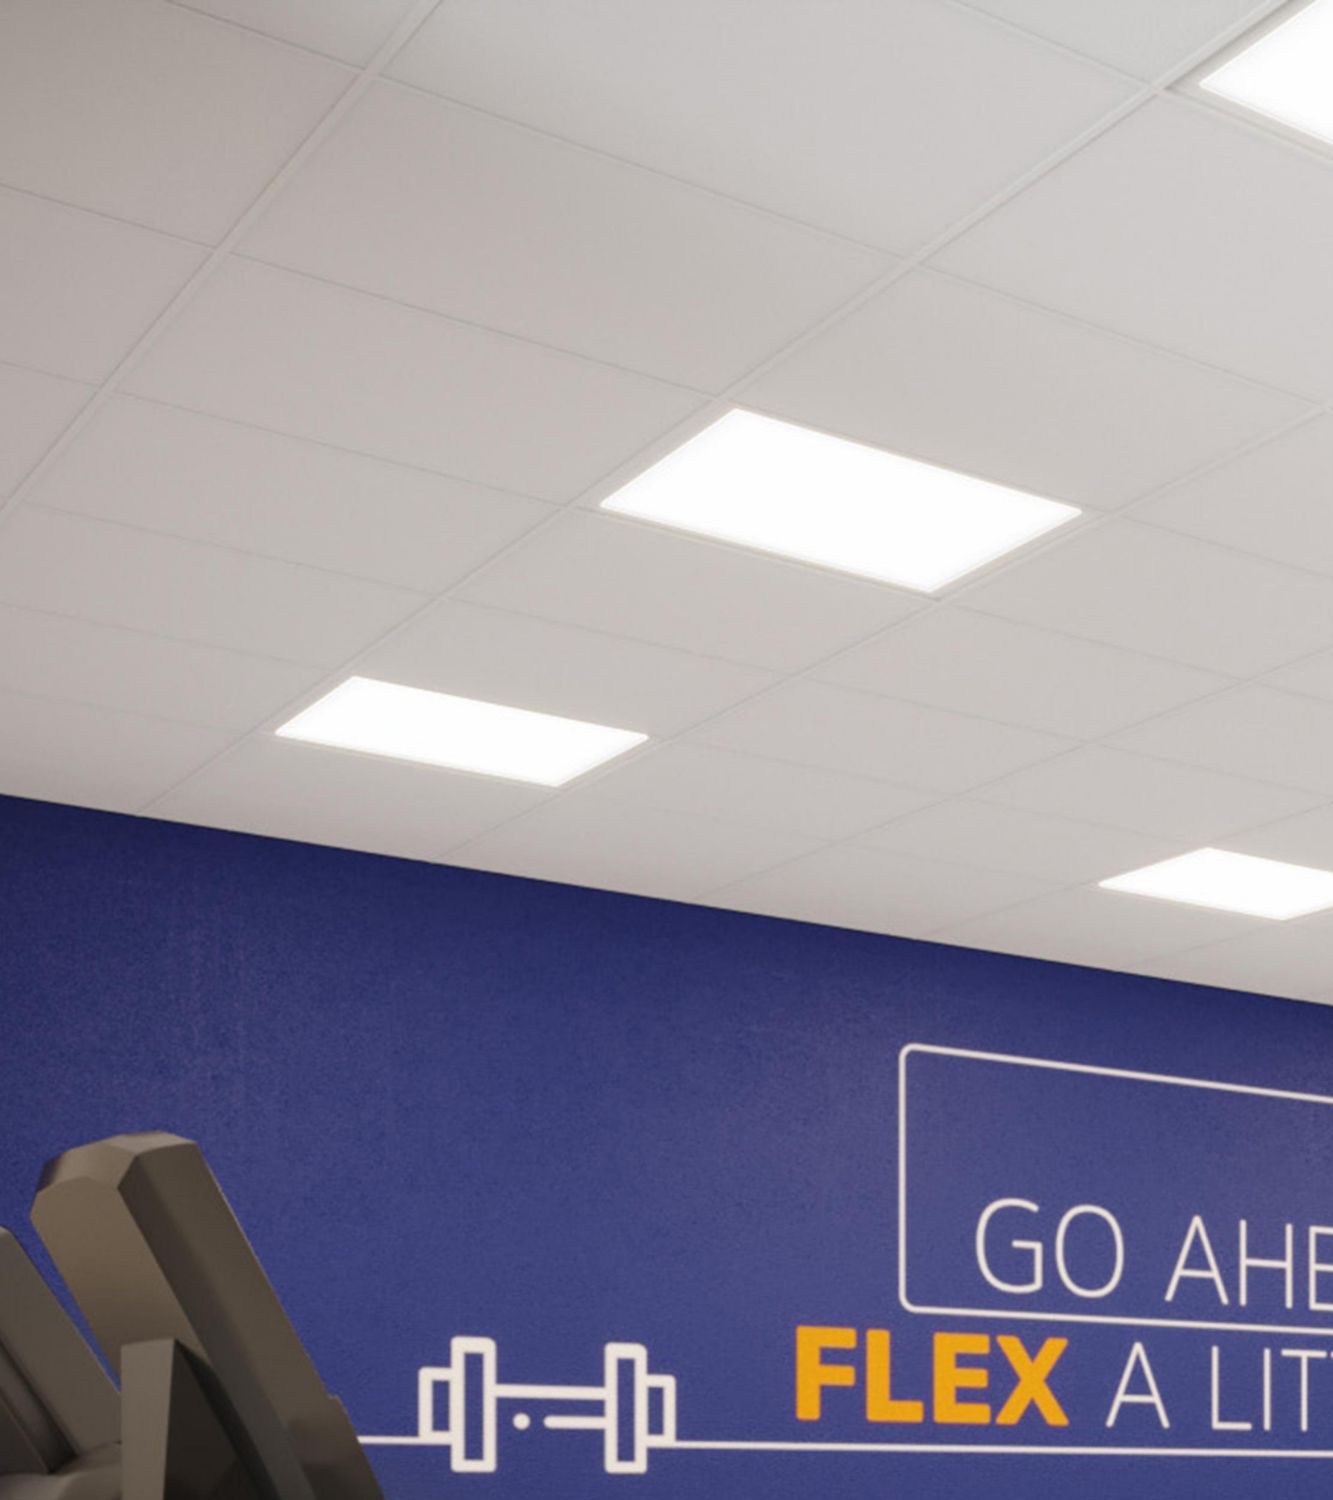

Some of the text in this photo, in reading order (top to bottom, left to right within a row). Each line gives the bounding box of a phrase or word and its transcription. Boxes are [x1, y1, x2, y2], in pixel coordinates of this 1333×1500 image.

[974, 1196, 1126, 1300] GO
[794, 1324, 1070, 1428] FLEX
[1104, 1340, 1170, 1431] A
